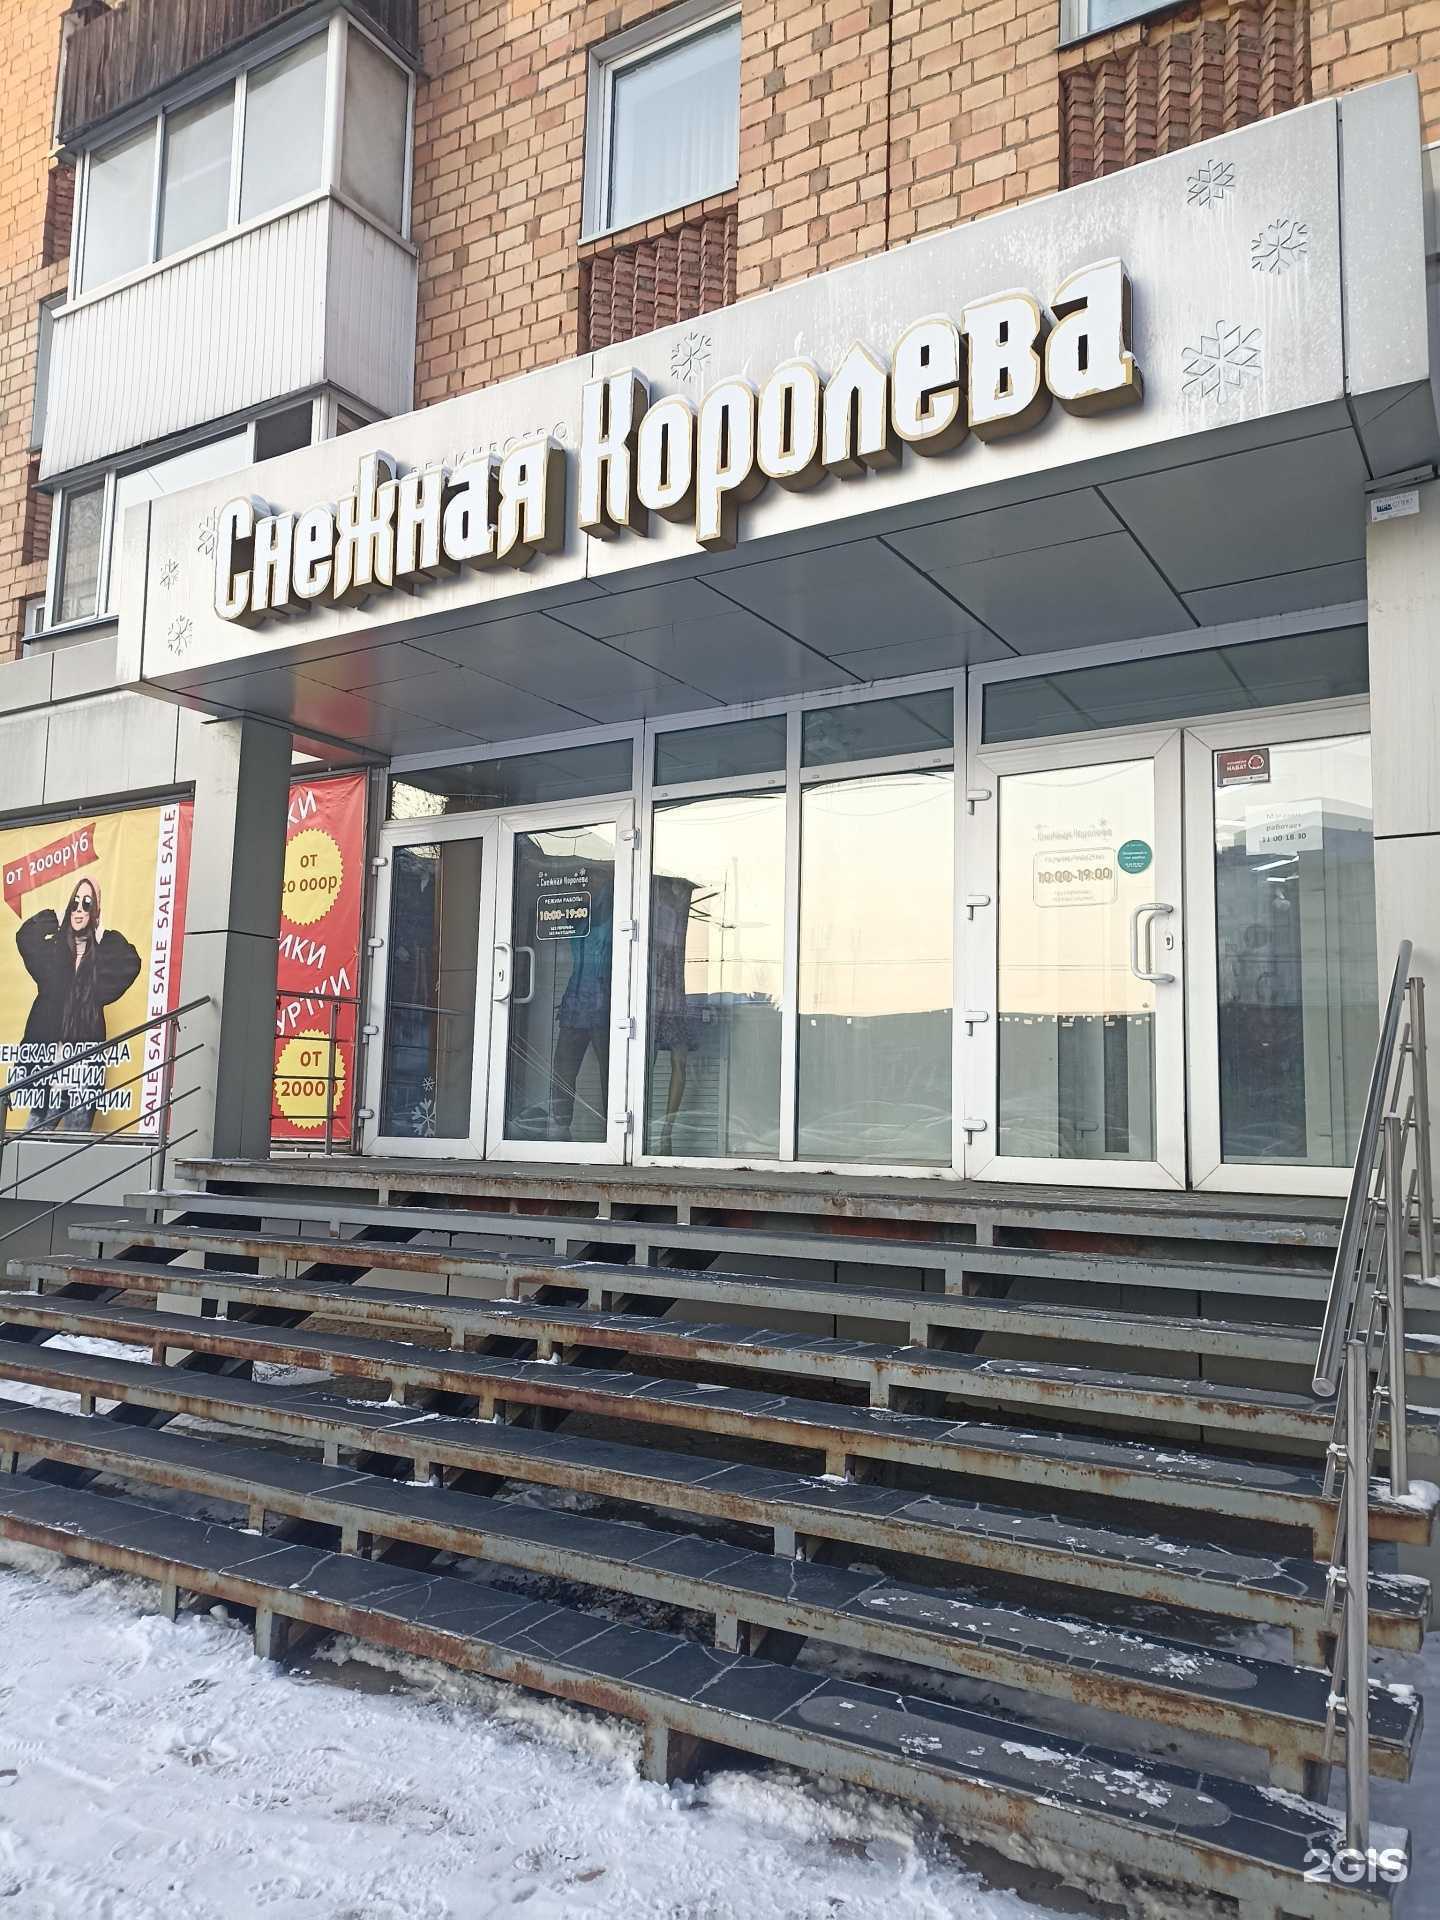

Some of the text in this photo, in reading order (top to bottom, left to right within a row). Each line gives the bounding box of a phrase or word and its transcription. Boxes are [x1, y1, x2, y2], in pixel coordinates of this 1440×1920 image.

[213, 256, 1140, 626] Снежная Королева
[162, 809, 176, 864] SALE
[157, 875, 172, 928] SALE
[540, 907, 588, 921] 10:00-19:00
[153, 940, 168, 994] SALE
[49, 1089, 61, 1108] И
[68, 1089, 131, 1112] ТУРЦИИ
[144, 1072, 158, 1127] SALE
